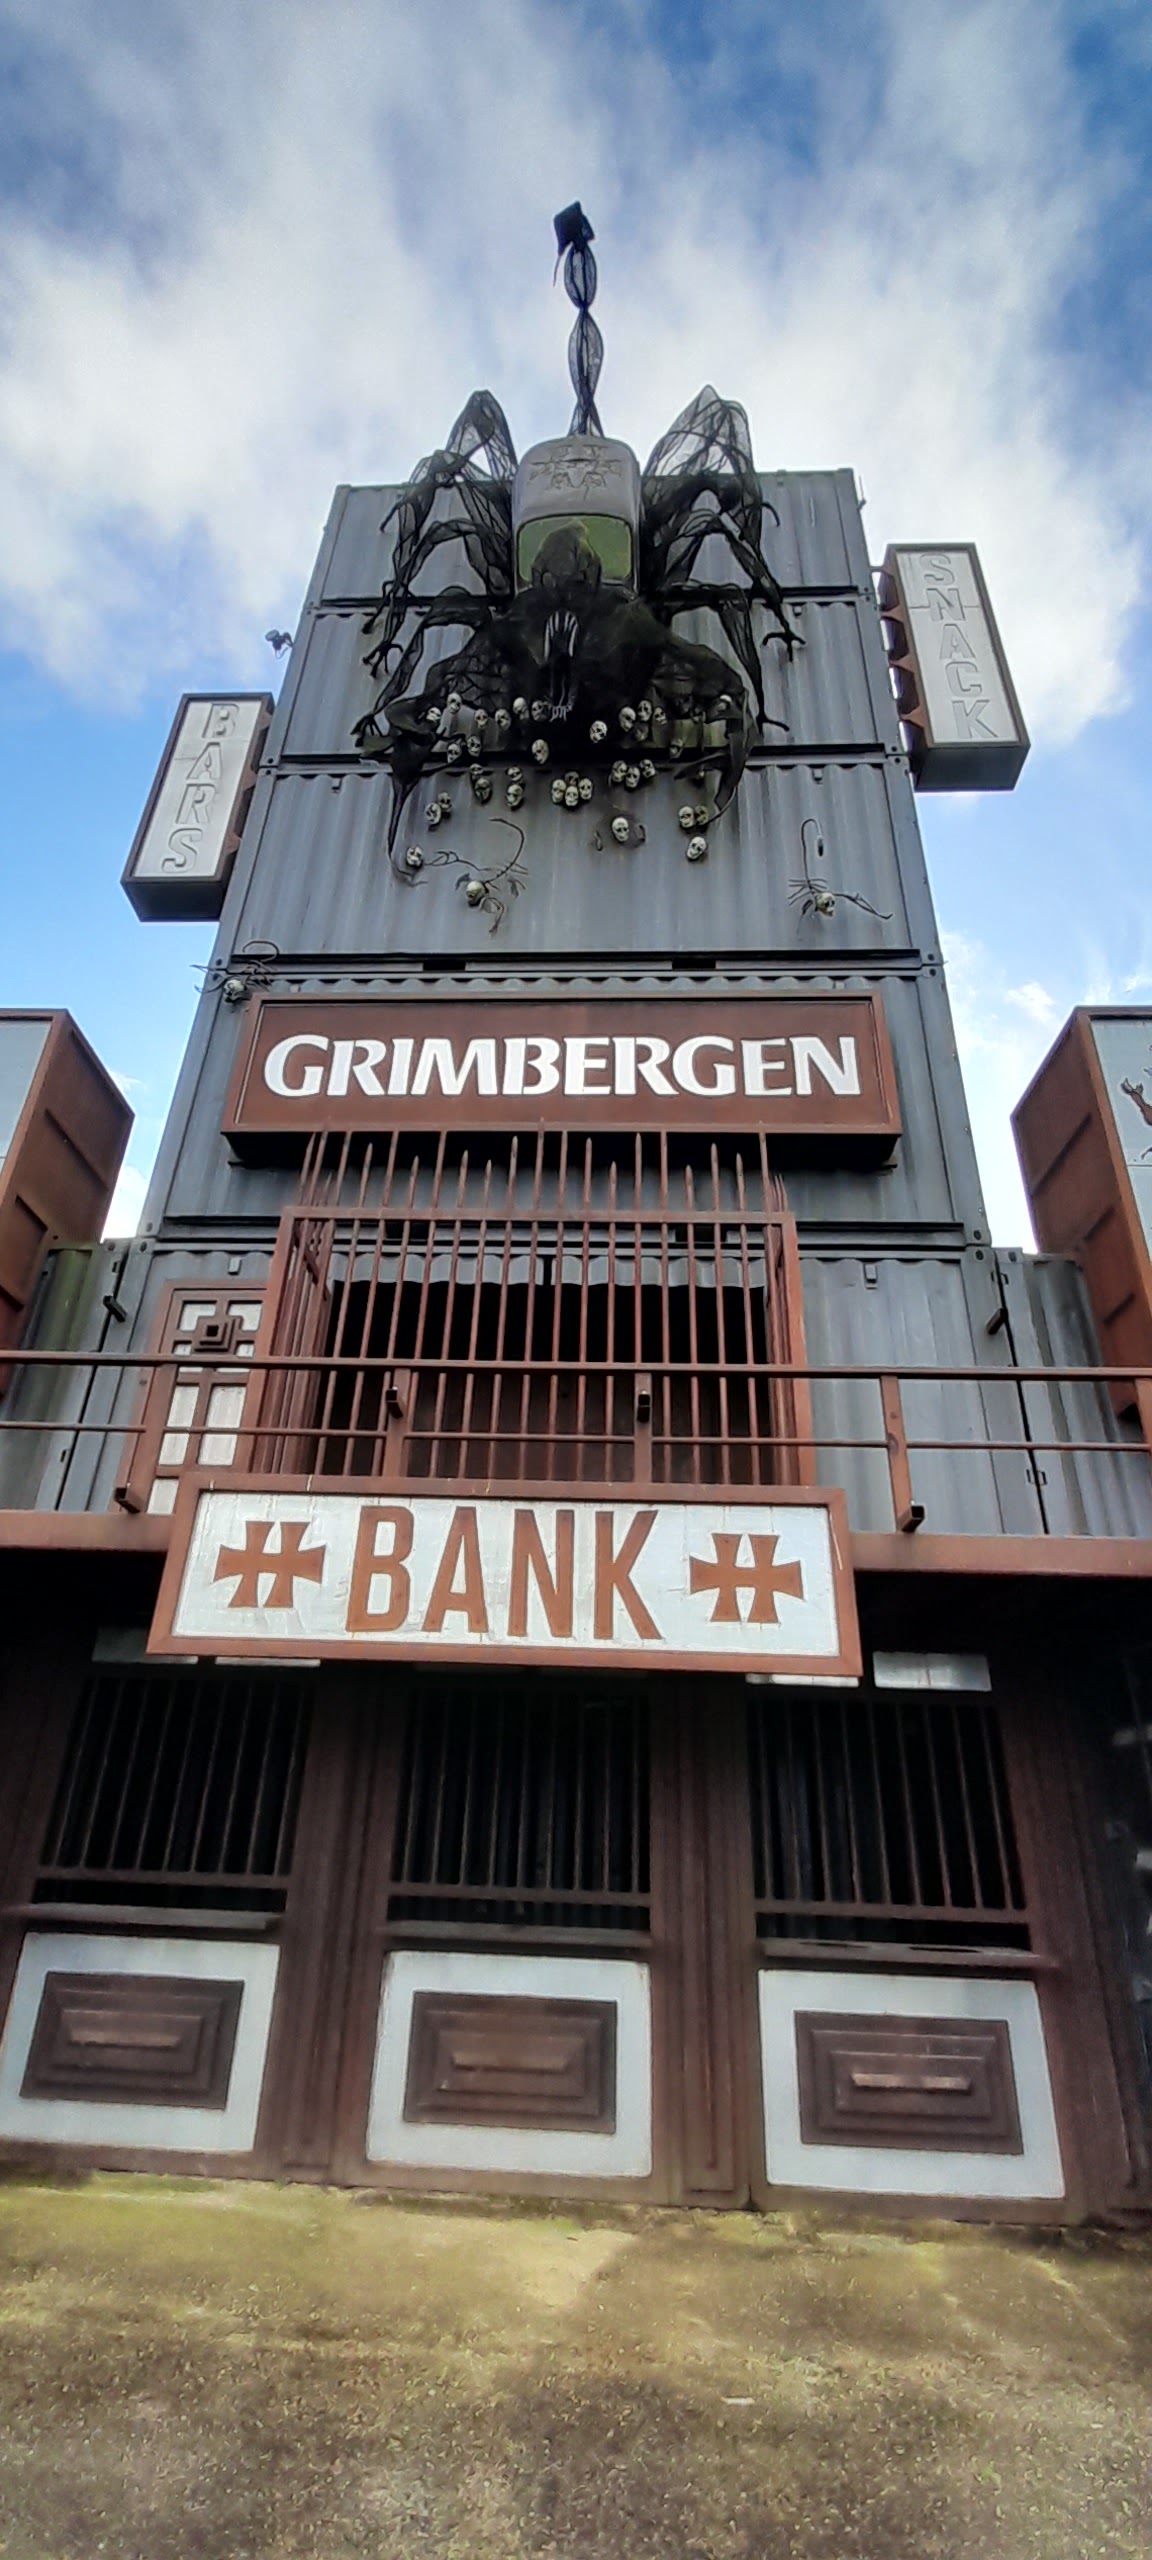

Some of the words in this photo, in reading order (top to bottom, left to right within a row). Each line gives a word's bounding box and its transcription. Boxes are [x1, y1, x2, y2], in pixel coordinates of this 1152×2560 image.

[919, 553, 999, 739] SNACK
[161, 703, 240, 874] BARS
[263, 1034, 862, 1097] GRIMBERGEN
[345, 1505, 662, 1641] BANK
